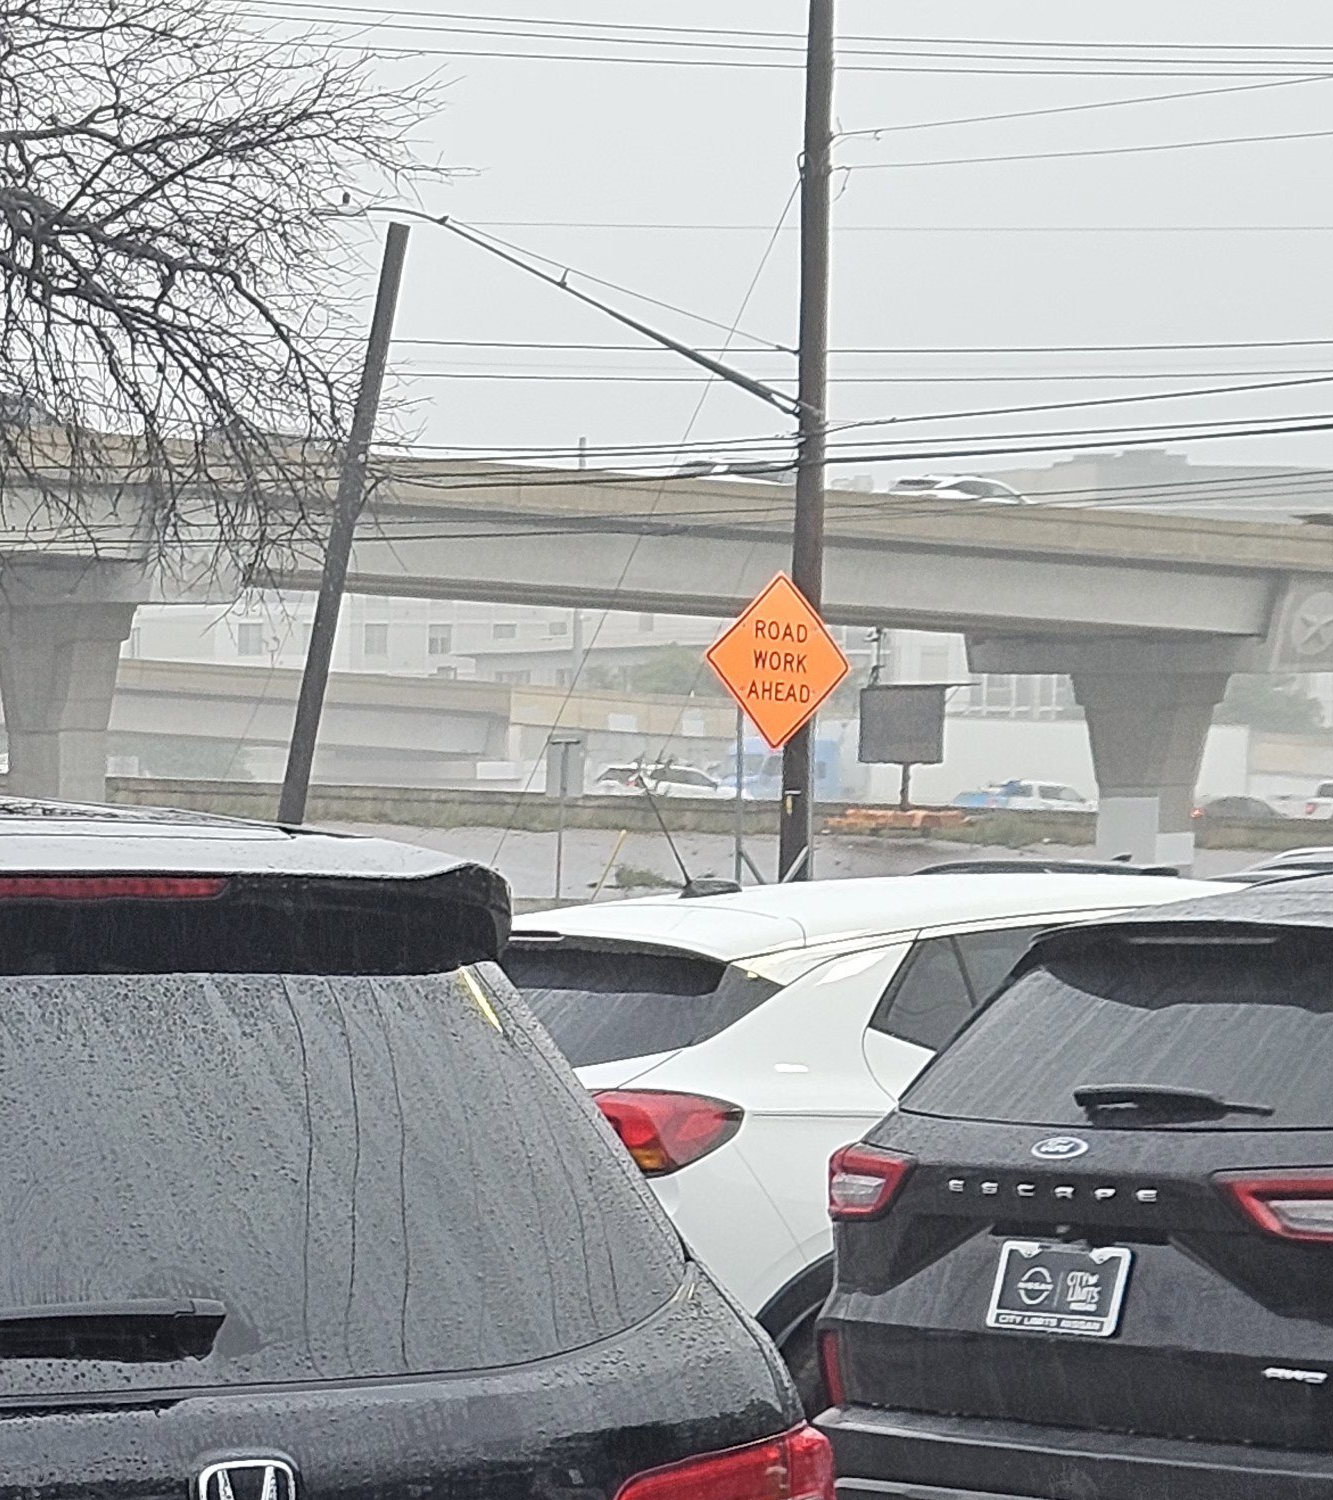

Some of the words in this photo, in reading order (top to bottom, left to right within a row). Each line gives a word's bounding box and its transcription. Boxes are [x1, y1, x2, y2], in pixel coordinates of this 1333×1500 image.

[754, 619, 808, 643] ROAD
[753, 649, 808, 674] WORK
[746, 680, 811, 704] AHEAD
[948, 1179, 1158, 1203] ESCAPE
[998, 1314, 1023, 1324] CITY
